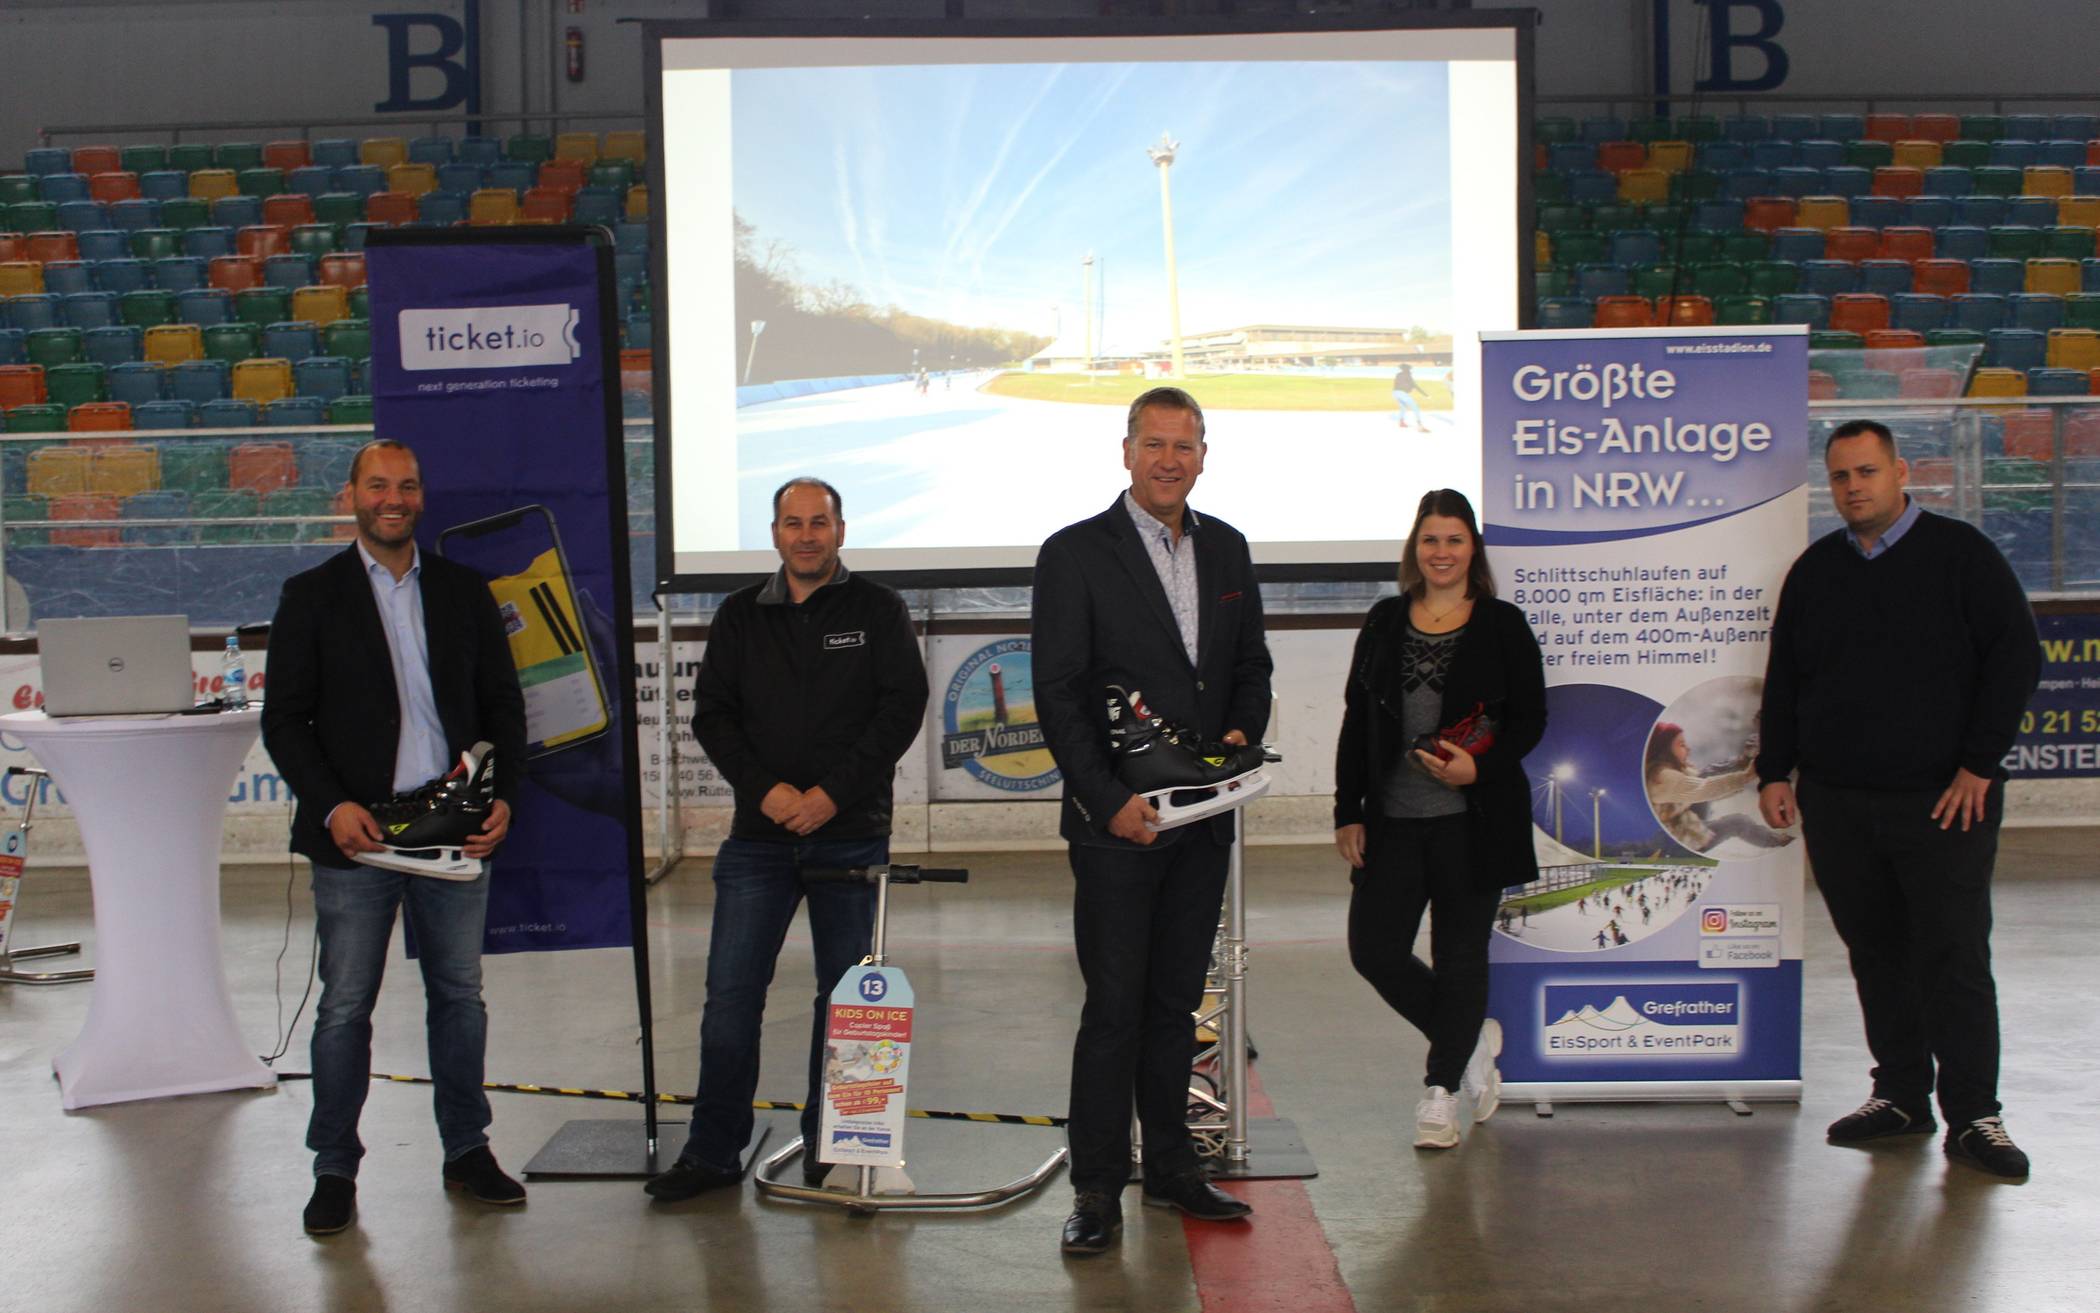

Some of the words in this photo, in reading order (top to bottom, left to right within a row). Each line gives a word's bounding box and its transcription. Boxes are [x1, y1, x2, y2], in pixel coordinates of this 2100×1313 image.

[1694, 0, 1790, 92] B
[372, 13, 469, 113] B
[426, 322, 545, 351] ticket.io
[418, 381, 443, 393] next
[446, 379, 507, 393] generation
[509, 376, 560, 388] ticketing
[1512, 362, 1677, 408] Größte
[1512, 416, 1773, 462] Eis-Anlage
[1513, 473, 1555, 510] in
[1573, 471, 1725, 509] NRW...
[1514, 566, 1691, 584] Schlittschuhlaufen
[1697, 564, 1728, 581] auf
[1514, 588, 1572, 604] 8.000
[1577, 589, 1605, 606] qm
[1612, 586, 1703, 603] Eisfläche:
[1709, 586, 1726, 602] in
[1732, 585, 1764, 601] der
[1524, 609, 1567, 627] alle,
[1573, 608, 1623, 625] unter
[1629, 607, 1669, 623] dem
[1675, 606, 1772, 624] Außenzelt
[1554, 629, 1584, 645] auf
[1590, 628, 1629, 645] dem
[1542, 653, 1564, 667] ter
[1571, 650, 1630, 666] freiem
[1637, 649, 1717, 665] Himmel!
[947, 649, 993, 702] ORIGINAL
[2042, 711, 2071, 733] 21
[950, 738, 981, 754] DER
[2001, 745, 2100, 770] ENSTE
[1727, 950, 1774, 960] Facebook
[862, 979, 884, 996] 13
[835, 1008, 863, 1019] KIDS
[866, 1010, 884, 1020] ON
[887, 1011, 908, 1021] ICE
[1643, 1000, 1734, 1017] Grefrather
[1550, 1035, 1622, 1051] EisSport
[1627, 1036, 1638, 1048] &
[1643, 1034, 1733, 1048] EventPark
